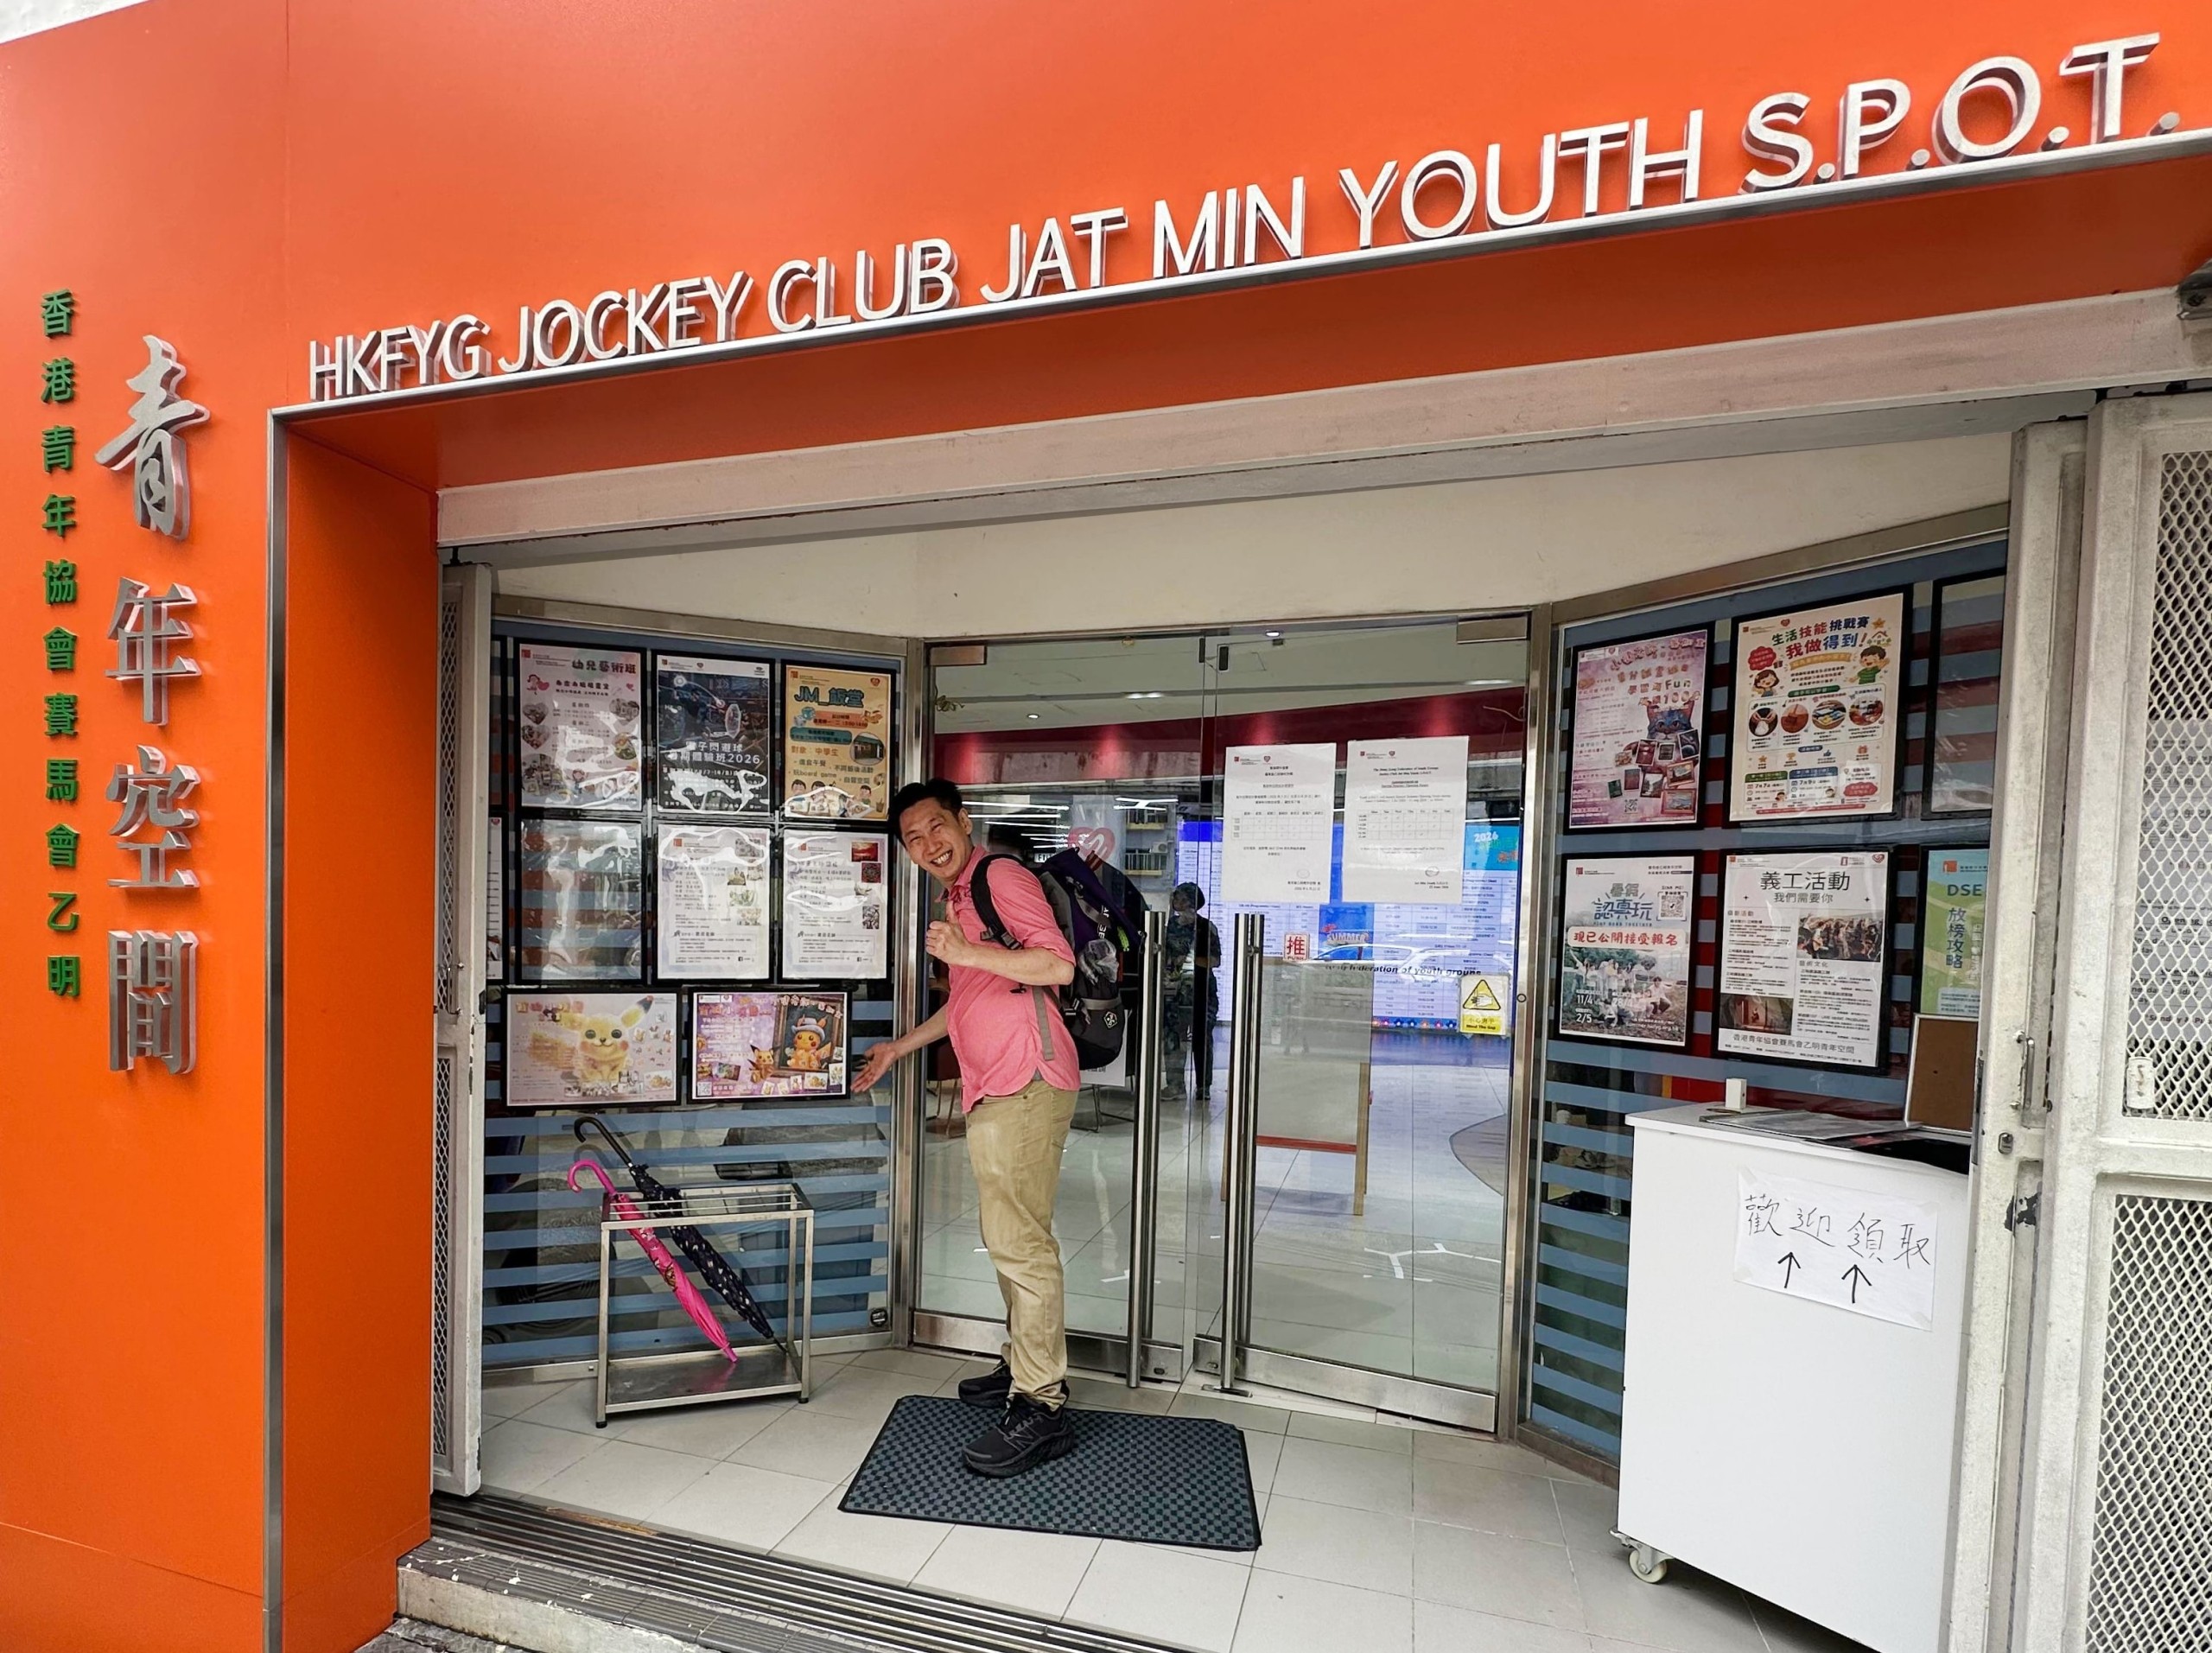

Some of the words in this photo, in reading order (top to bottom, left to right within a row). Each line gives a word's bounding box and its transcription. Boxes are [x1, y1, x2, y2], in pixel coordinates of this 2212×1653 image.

[309, 312, 492, 401] HKFYG
[498, 270, 753, 375] JOCKEY
[767, 237, 959, 334] CLUB
[980, 207, 1129, 305] JAT
[1153, 175, 1306, 280] MIN
[1338, 108, 1704, 251] YOUTH
[1738, 32, 2182, 196] S.P.O.T.
[1771, 616, 1871, 646] 生活技能挑戰賽
[40, 288, 81, 999] 香港青年協會賽馬會乙明
[94, 334, 212, 1076] 青年空間
[794, 685, 864, 708] JM_飯堂
[1473, 831, 1499, 842] 2026
[1610, 882, 1639, 898] 暑假
[1760, 870, 1851, 891] 義工活動
[1947, 884, 1983, 896] DSE
[1774, 892, 1834, 904] 我們需要你
[1592, 898, 1654, 921] 認真玩
[1286, 936, 1306, 956] 推
[1573, 931, 1678, 945] 現已公開接受報名
[1946, 907, 1967, 969] 放榜攻略
[1401, 965, 1411, 975] of
[1576, 994, 1593, 1004] 11/4
[1575, 1012, 1592, 1023] 2/5
[1732, 1033, 1855, 1054] 香港青年協會賽馬會乙明青年空間
[1745, 1194, 1931, 1270] 歡迎領取
